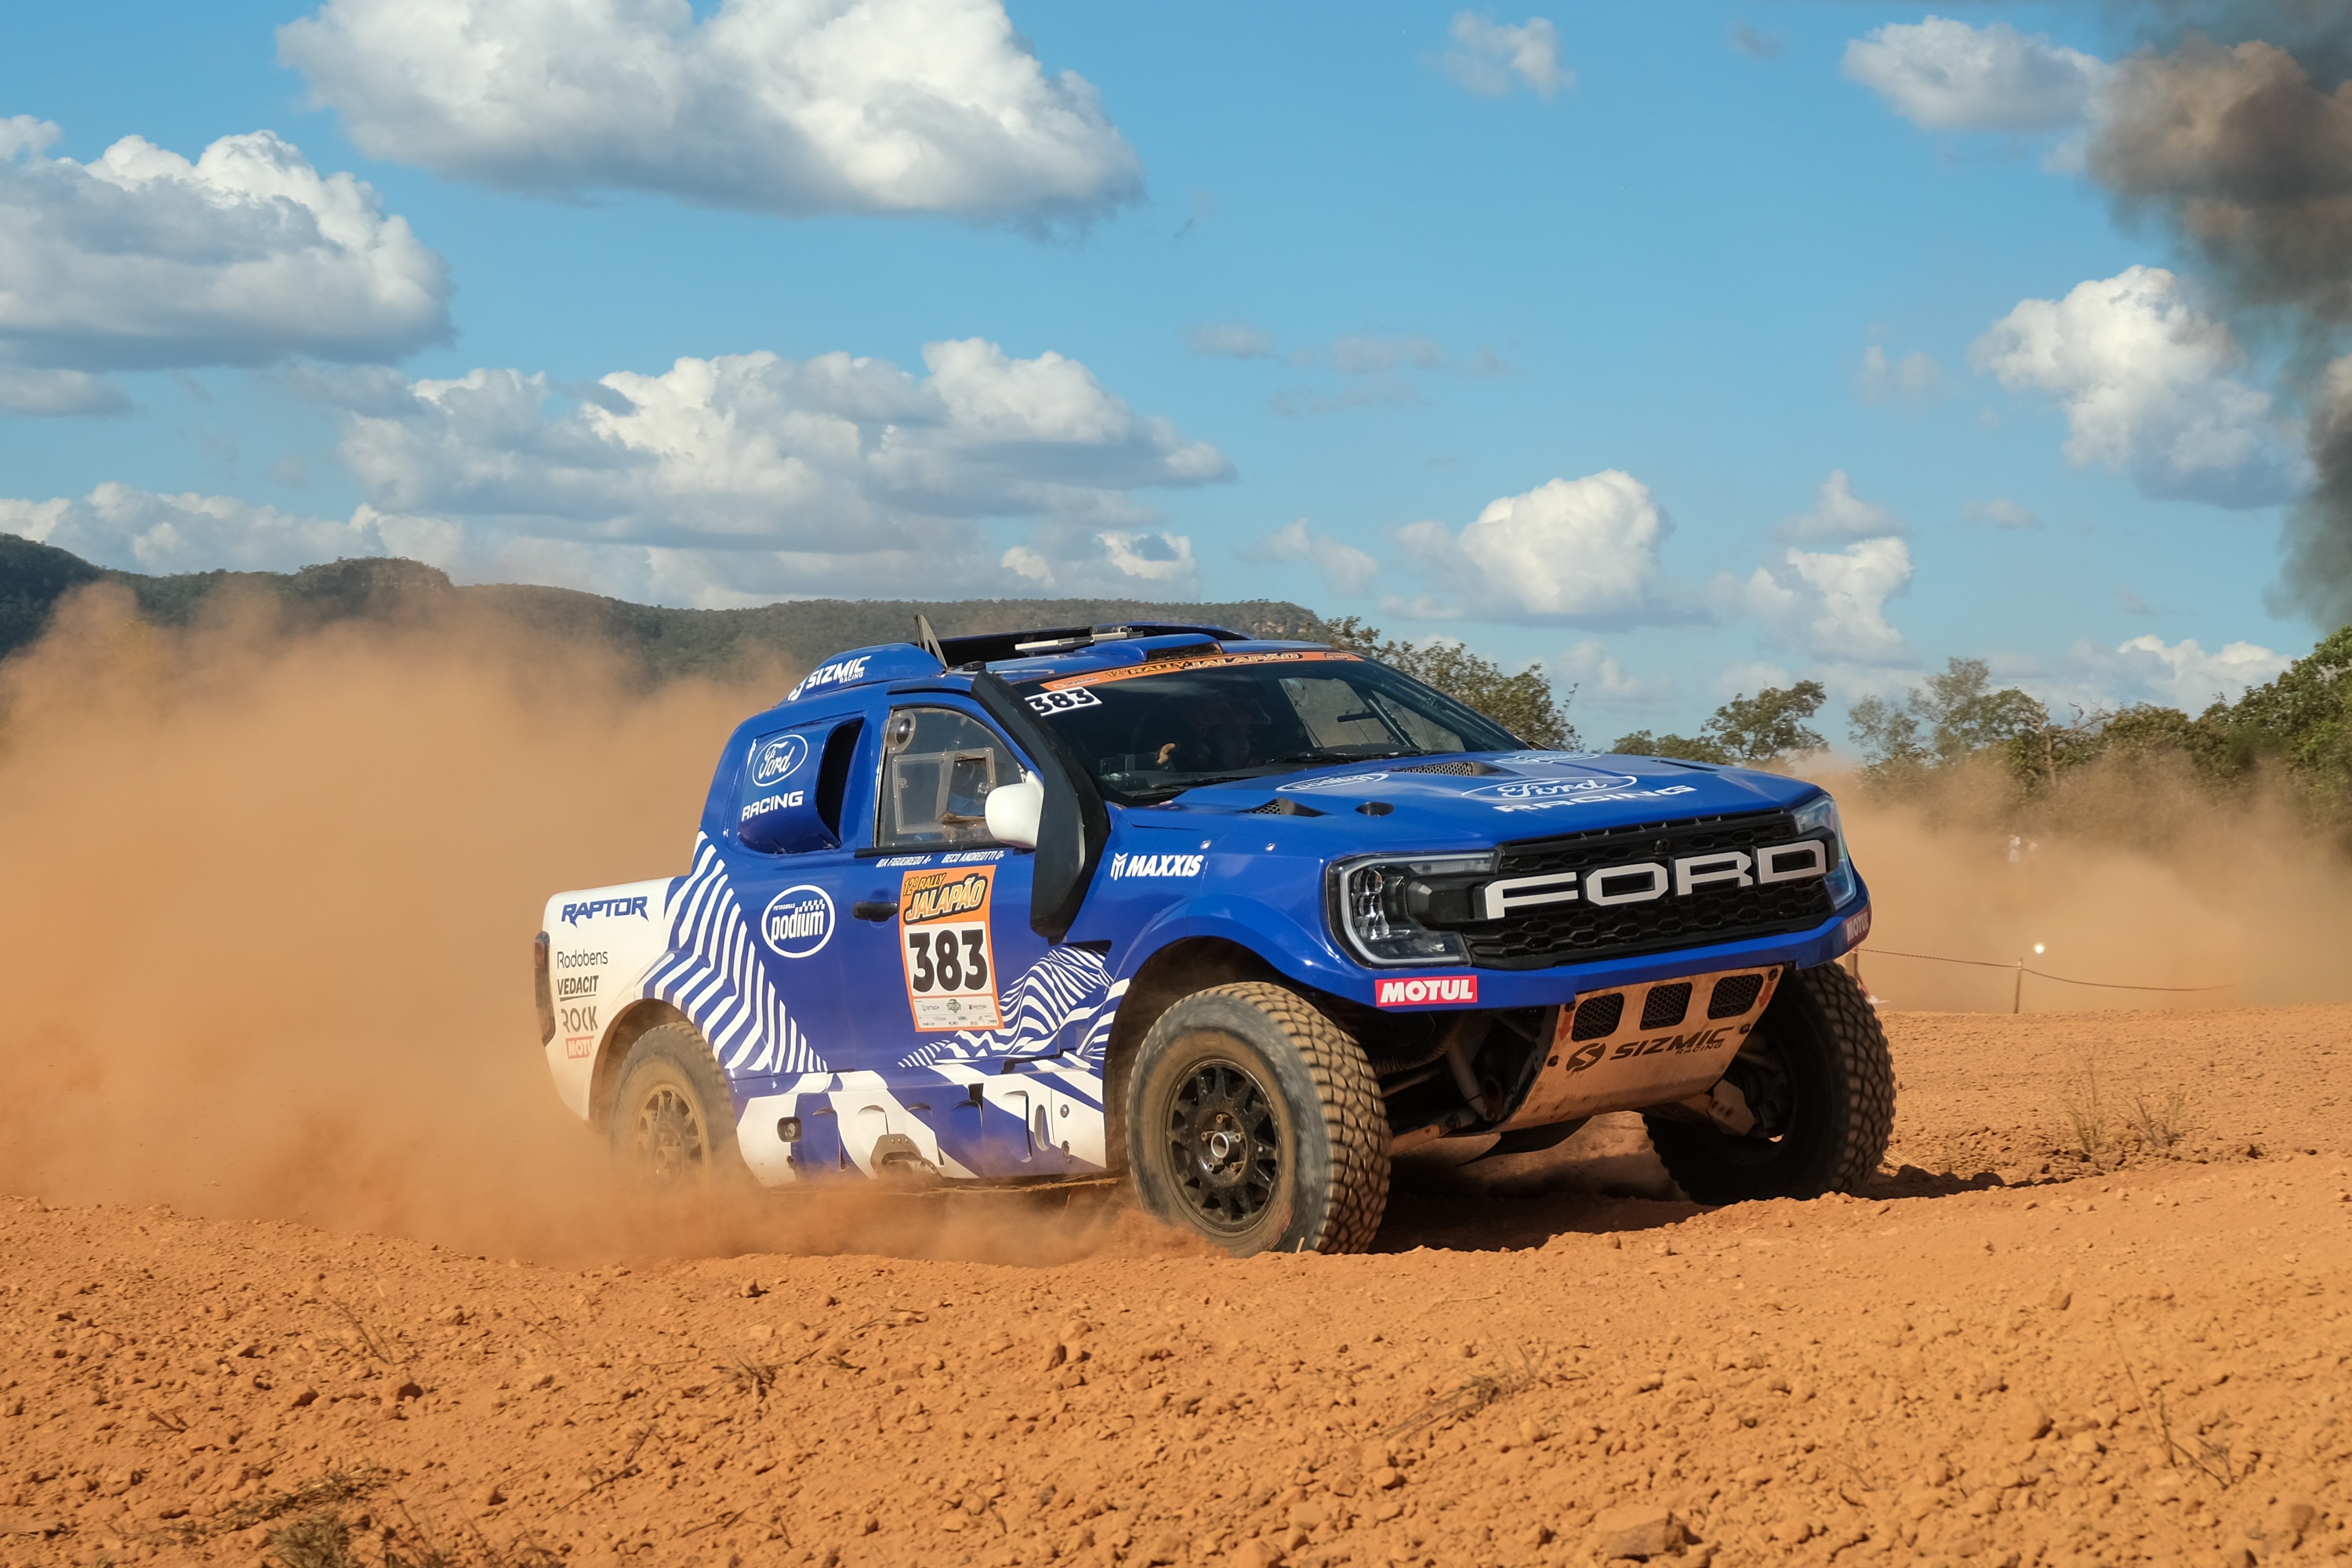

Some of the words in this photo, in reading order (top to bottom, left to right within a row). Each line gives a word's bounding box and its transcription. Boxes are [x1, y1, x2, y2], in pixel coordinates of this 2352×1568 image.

[806, 655, 872, 689] SIZMIC
[1128, 662, 1185, 675] RALLY
[1182, 652, 1302, 670] JALAPÃO
[839, 671, 864, 684] RACING
[1029, 688, 1095, 713] 383
[758, 741, 796, 779] Ford
[1493, 785, 1697, 812] RACING
[1497, 779, 1607, 797] Ford
[741, 790, 804, 822] RACING
[1125, 855, 1204, 877] MAXXIS
[1485, 839, 1827, 920] FORD
[917, 873, 947, 891] RALLY
[561, 896, 649, 928] RAPTOR
[904, 874, 988, 924] JALAPÃO
[771, 907, 824, 945] podium
[1846, 911, 1869, 942] MOTUL
[557, 949, 608, 969] Rodobens
[909, 929, 988, 993] 383
[557, 975, 599, 996] VEDACIT
[1380, 979, 1474, 1003] MOTUL
[561, 1005, 598, 1033] ROCK
[1609, 1026, 1735, 1060] SIZMIC
[1675, 1042, 1722, 1055] RACING
